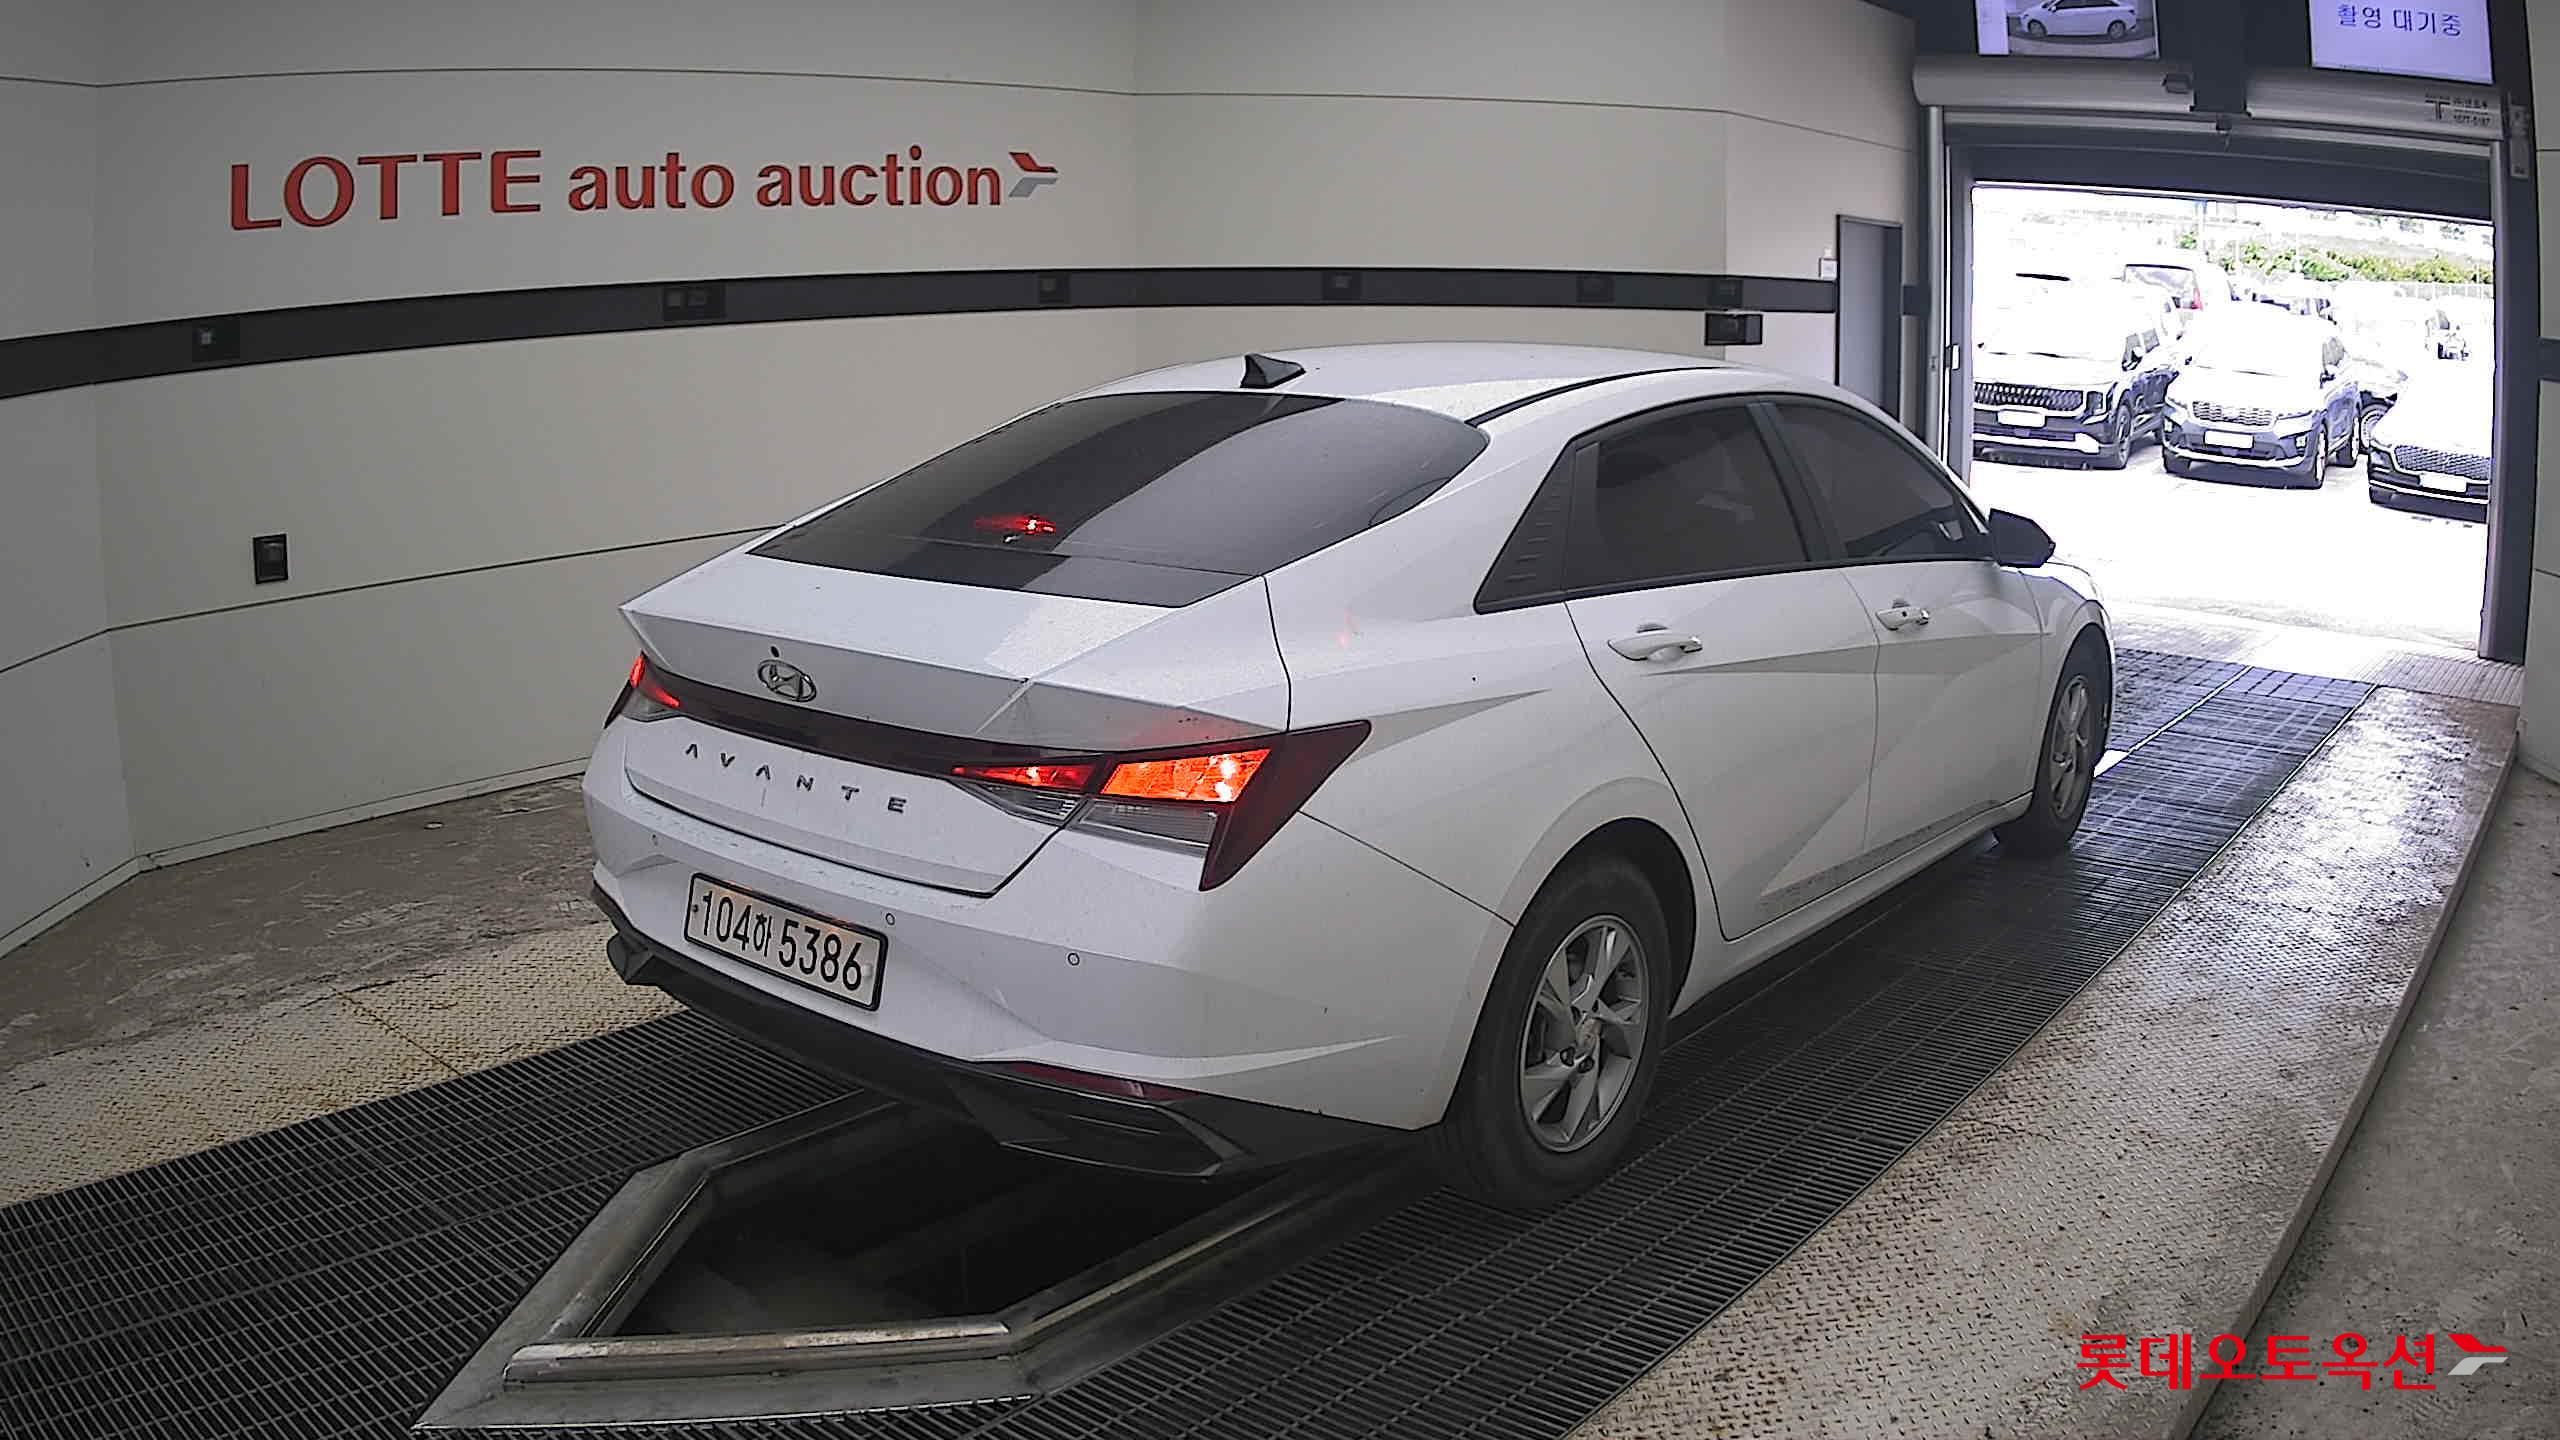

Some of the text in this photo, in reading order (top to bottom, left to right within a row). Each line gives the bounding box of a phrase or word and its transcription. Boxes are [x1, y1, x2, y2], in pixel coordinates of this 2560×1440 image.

[2338, 4, 2461, 37] 촬영 대기중
[230, 146, 1003, 230] LOTTE auto auction
[685, 743, 908, 814] AVANTE
